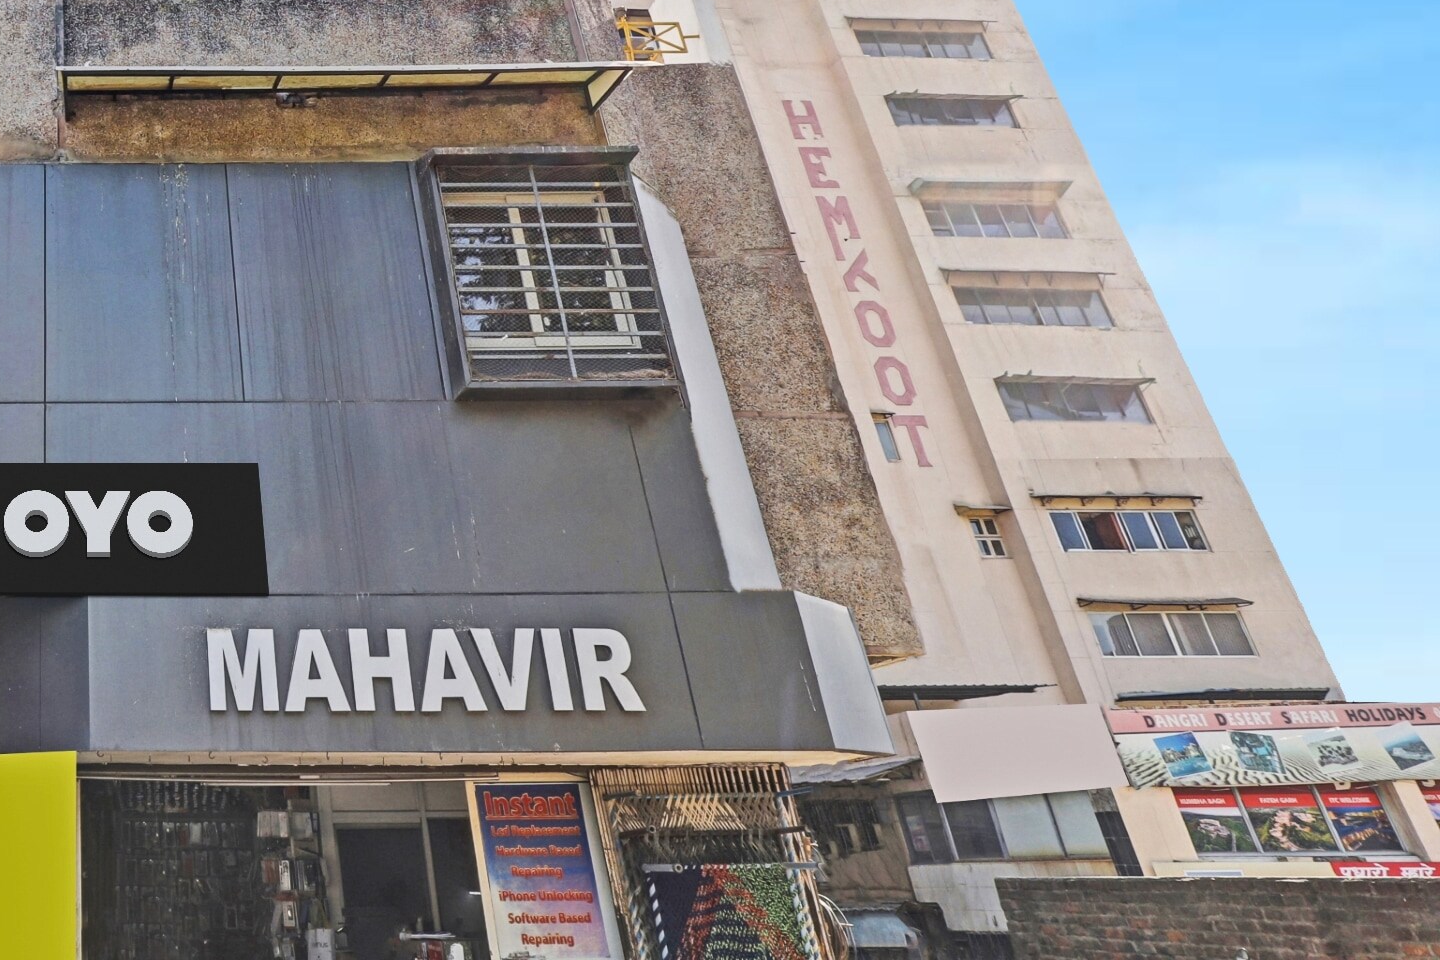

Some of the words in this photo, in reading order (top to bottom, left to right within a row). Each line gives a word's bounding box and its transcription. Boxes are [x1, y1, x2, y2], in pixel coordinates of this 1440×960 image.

[782, 99, 933, 467] HEMKOOT
[4, 490, 193, 557] OYO
[206, 627, 646, 712] MAHAVIR
[1143, 714, 1208, 728] DANGRI
[1215, 712, 1273, 726] DESERT
[1281, 709, 1339, 724] SAFARI
[1344, 707, 1426, 722] HOLIDAYS
[483, 791, 578, 817] Instant
[511, 825, 580, 839] Replacement
[495, 845, 548, 856] Hardware
[549, 844, 582, 856] Based
[510, 865, 564, 879] Repairing
[499, 890, 537, 901] iPhone
[538, 889, 593, 903] Unlocking
[508, 912, 556, 924] Software
[558, 912, 592, 924] Based
[521, 933, 574, 947] Repairing
